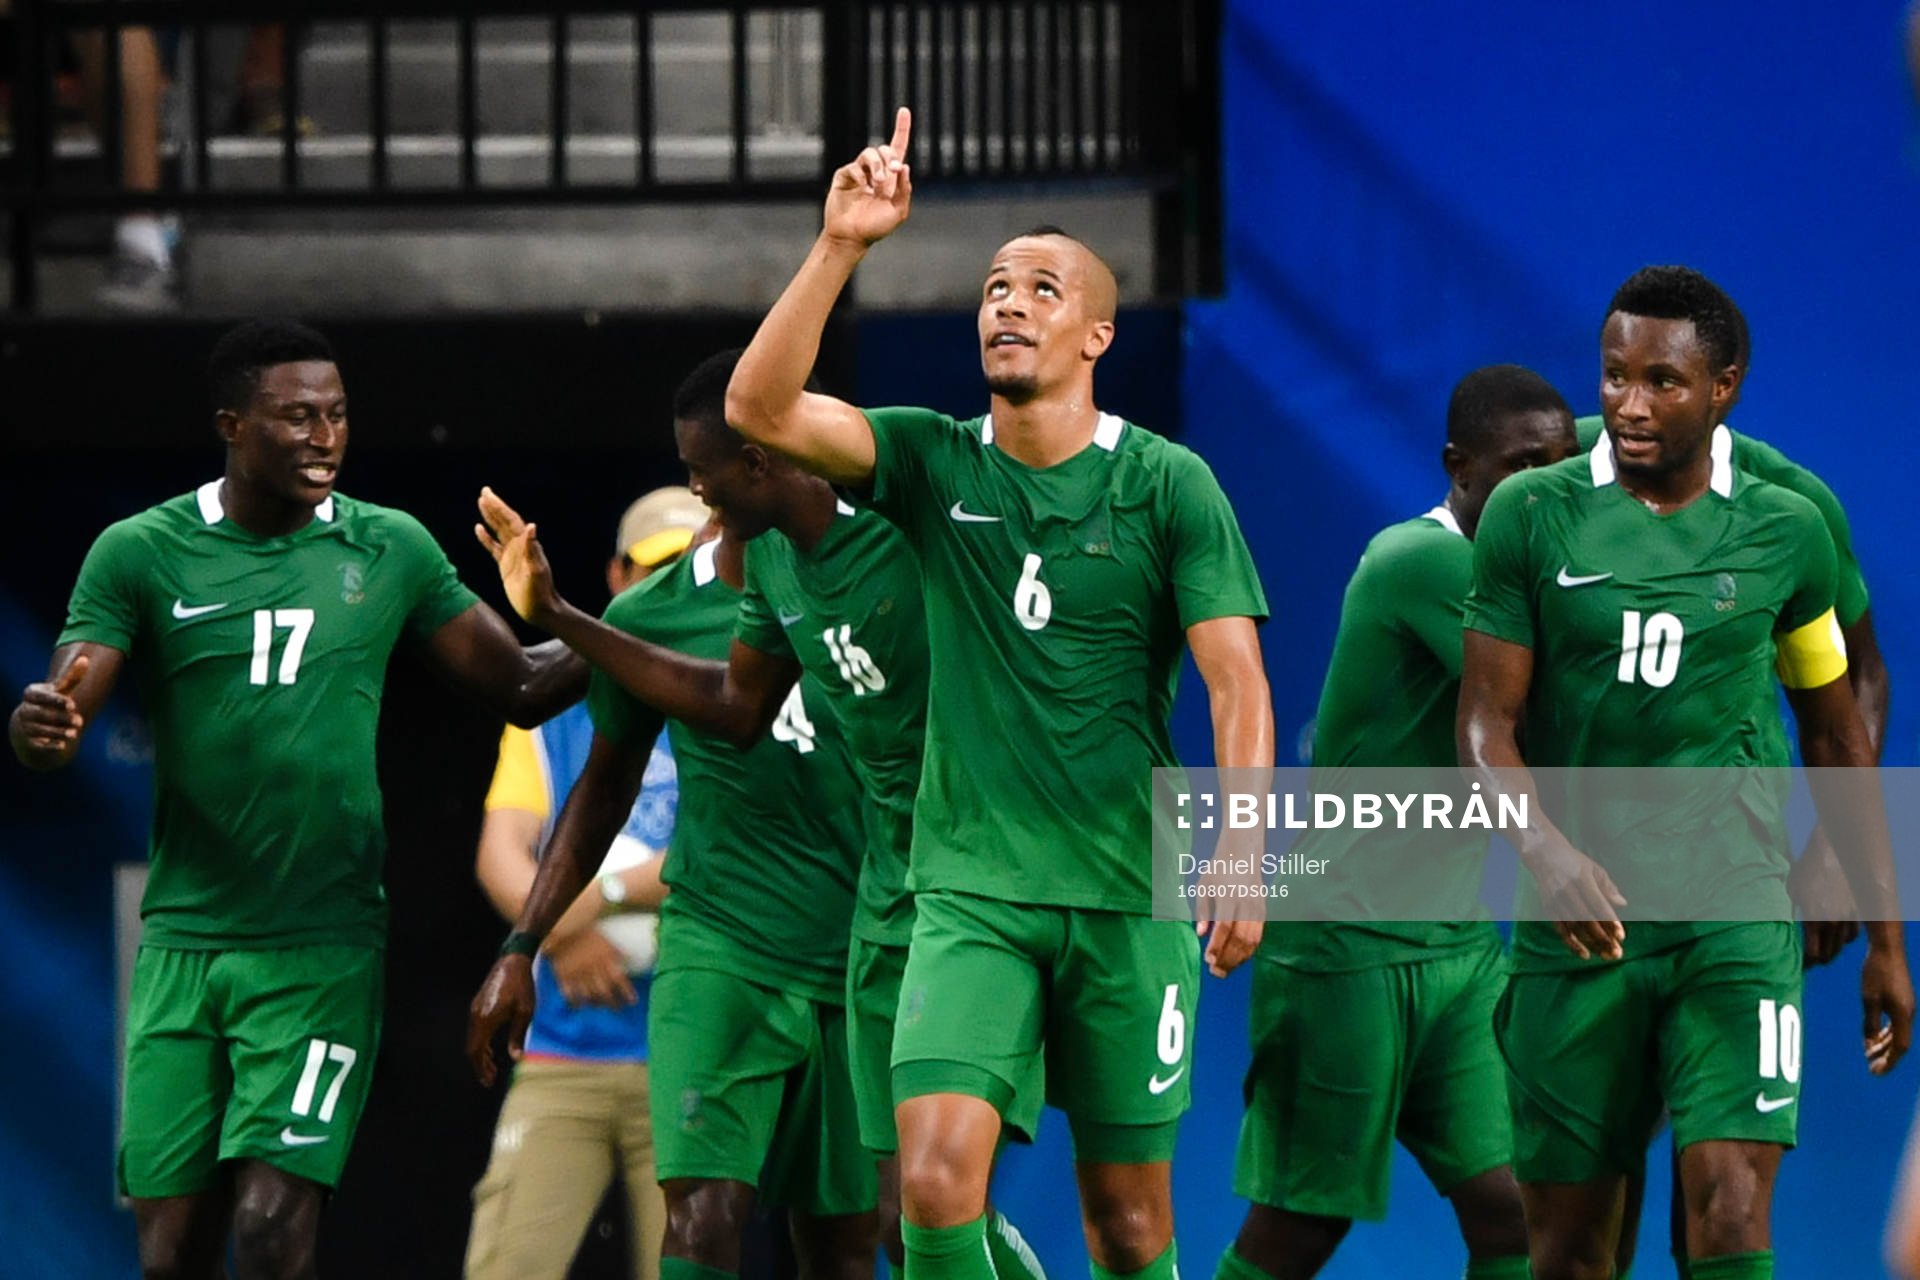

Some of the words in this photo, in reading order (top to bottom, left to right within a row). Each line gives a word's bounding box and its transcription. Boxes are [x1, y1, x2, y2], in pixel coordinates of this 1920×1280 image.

[1014, 553, 1051, 630] 6
[250, 609, 314, 685] 17
[823, 624, 885, 696] 16
[1618, 610, 1684, 688] 10
[772, 681, 815, 753] 4
[1157, 984, 1184, 1065] 6
[1759, 999, 1800, 1083] 10
[291, 1038, 356, 1123] 17
